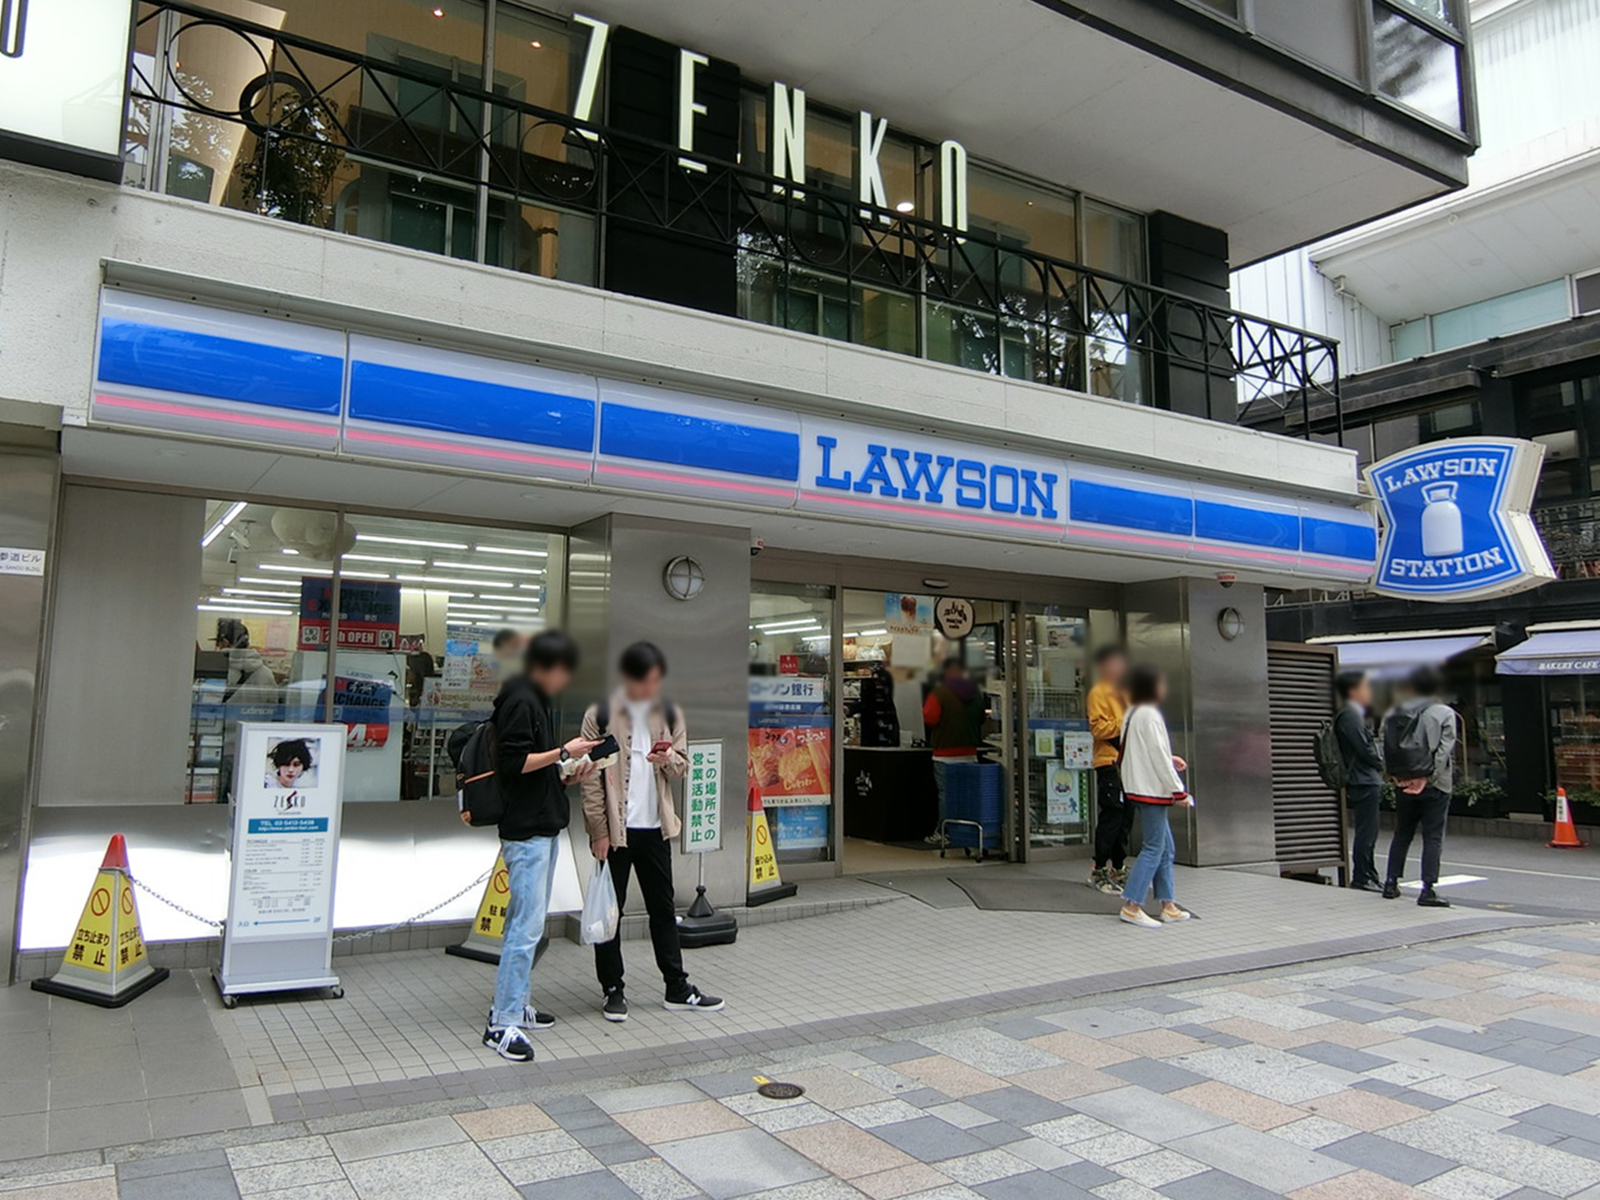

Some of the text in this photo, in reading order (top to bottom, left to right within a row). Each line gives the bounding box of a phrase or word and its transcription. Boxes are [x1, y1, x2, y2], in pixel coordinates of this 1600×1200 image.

[570, 13, 968, 245] ZENKO
[815, 435, 1058, 519] LAWSON
[1385, 458, 1498, 493] LAWSON
[1390, 547, 1504, 577] STATION
[324, 631, 374, 643] 2h OPEN
[1539, 661, 1573, 670] BAKERY
[690, 752, 704, 842] 営業活動禁止
[704, 752, 717, 841] この場所での
[77, 928, 110, 946] 立ち止まり
[72, 944, 106, 966] 禁止
[121, 941, 142, 965] 禁止
